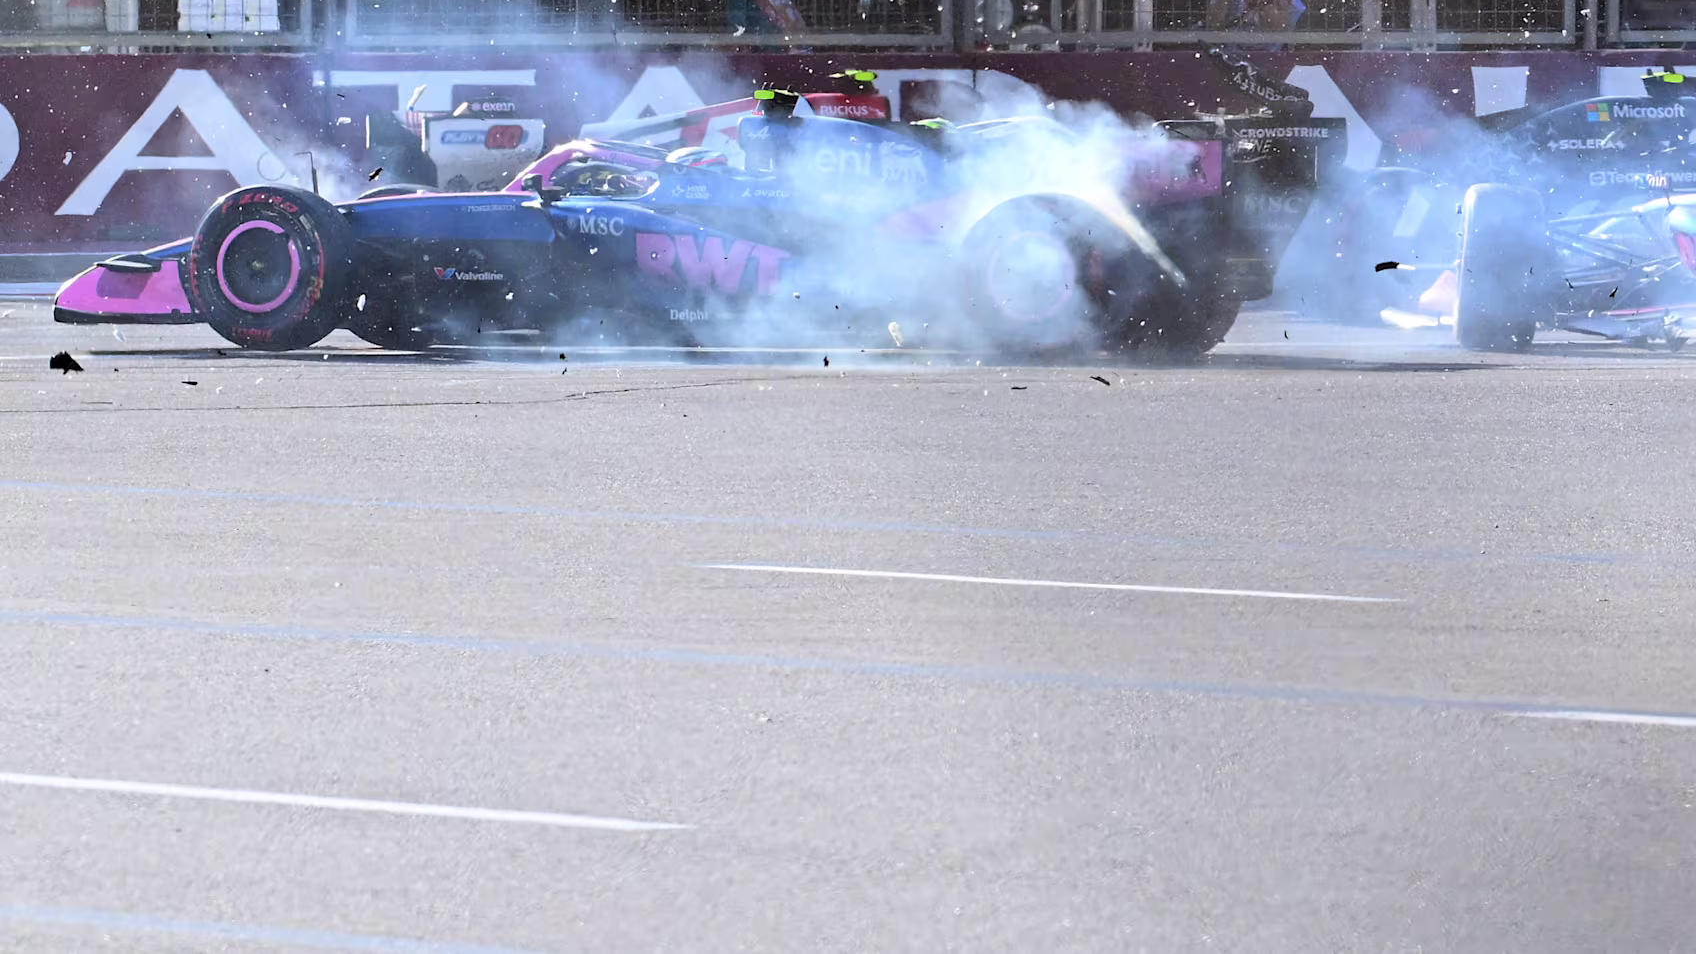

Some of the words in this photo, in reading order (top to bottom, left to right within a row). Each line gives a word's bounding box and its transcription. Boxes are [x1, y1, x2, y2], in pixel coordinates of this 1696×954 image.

[820, 106, 869, 117] RUCKUS
[1613, 103, 1686, 119] Microsoft
[1239, 128, 1329, 138] CROWDSTRIKE
[579, 215, 625, 236] MSC
[455, 271, 504, 281] Valvoline
[670, 309, 708, 322] Delphi
